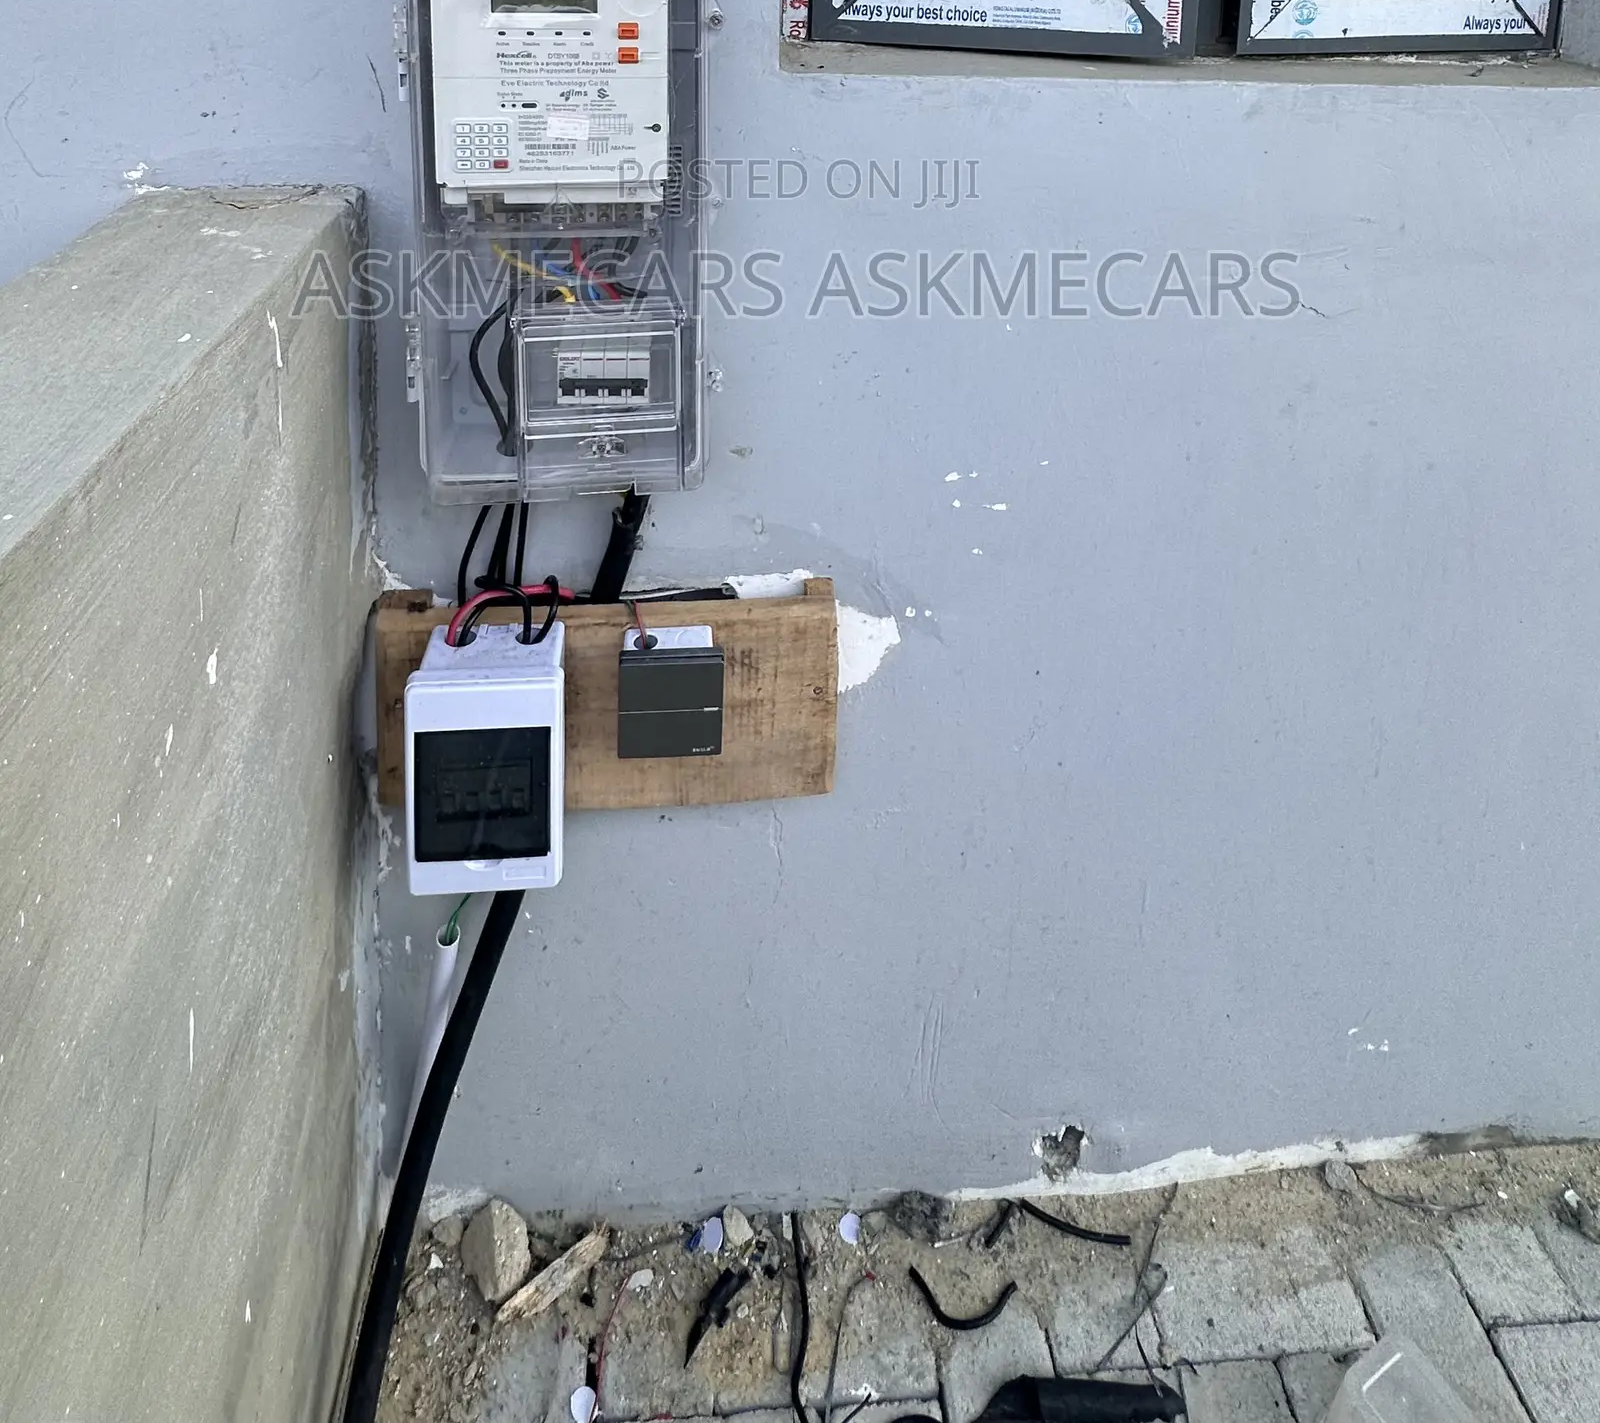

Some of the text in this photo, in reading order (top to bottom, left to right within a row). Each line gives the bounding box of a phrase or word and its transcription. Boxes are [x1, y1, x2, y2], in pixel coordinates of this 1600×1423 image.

[885, 6, 914, 22] your
[917, 4, 944, 22] best
[946, 7, 987, 24] choice
[1463, 15, 1501, 33] Always
[546, 80, 586, 88] Technology
